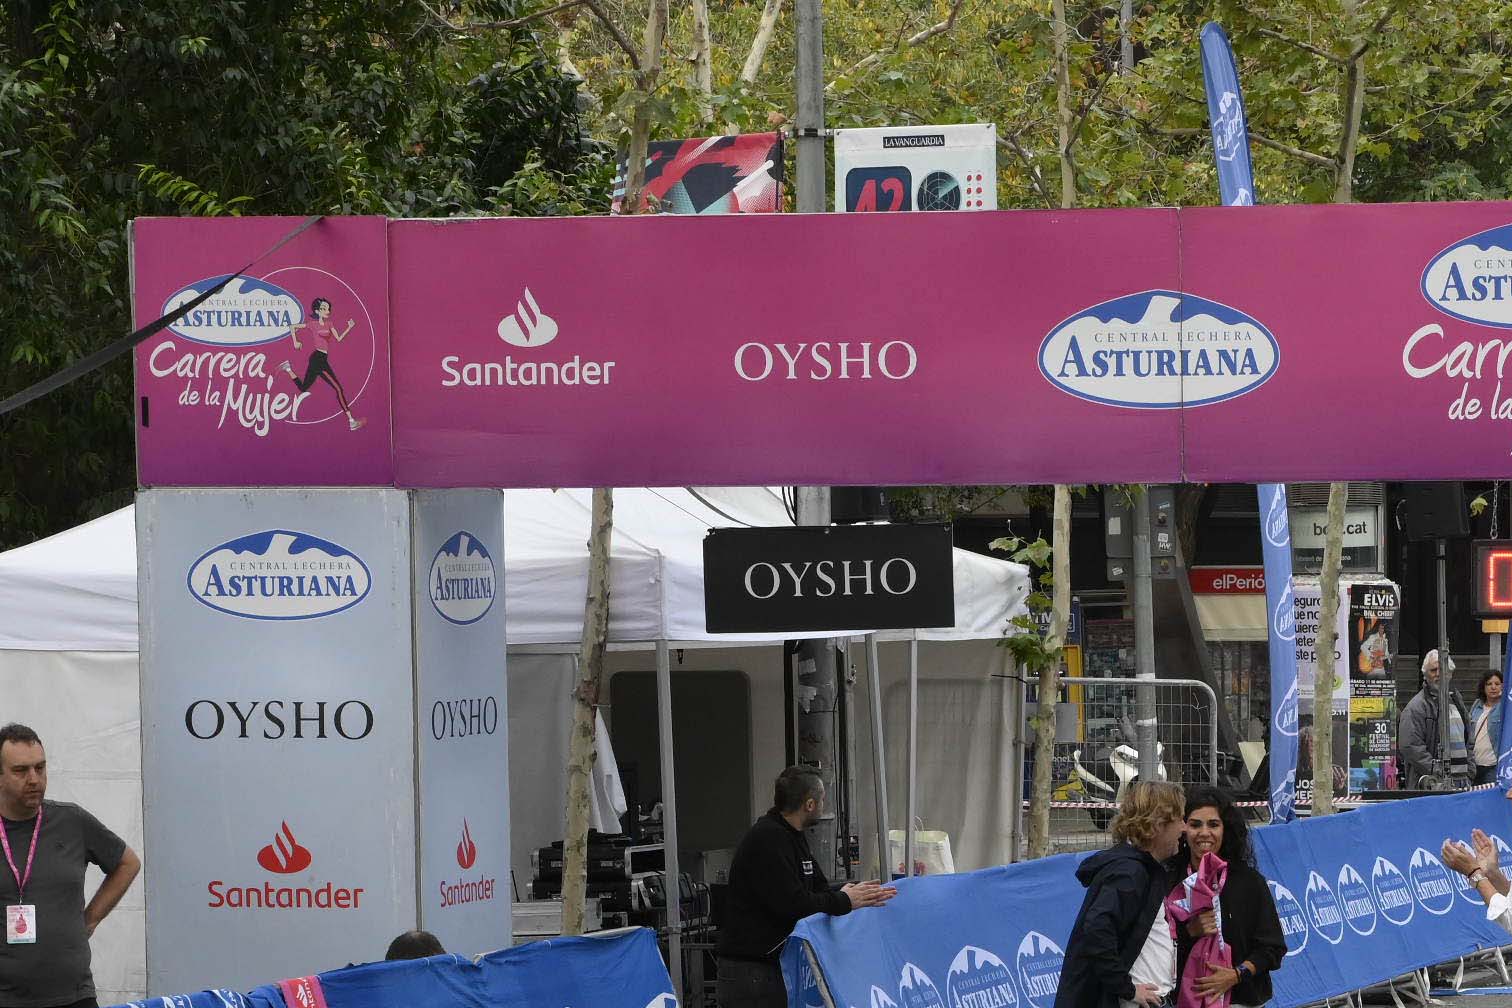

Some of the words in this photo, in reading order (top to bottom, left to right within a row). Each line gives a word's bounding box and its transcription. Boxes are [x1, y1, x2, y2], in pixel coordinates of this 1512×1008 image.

[885, 138, 894, 147] LA
[894, 136, 944, 147] VANGUARDIA
[173, 301, 293, 328] ASTURIANA
[201, 299, 239, 307] ENTRAL
[243, 299, 289, 307] LECHERA
[1094, 331, 1169, 342] CENTRAL
[1176, 330, 1254, 342] LECHERA
[149, 340, 266, 379] Carrera
[441, 355, 616, 388] Santander
[734, 340, 918, 381] OYSHO
[1056, 334, 1261, 378] ASTURIANA
[178, 380, 200, 406] de
[205, 379, 221, 406] la
[217, 375, 312, 437] Mujer
[1448, 382, 1483, 421] de
[201, 563, 359, 597] ASTURIANA
[230, 561, 288, 571] CENTRAL
[294, 560, 352, 571] LECHERA
[743, 557, 918, 599] OYSHO
[1212, 572, 1265, 591] elPerió
[434, 566, 493, 601] ASTURIANA
[1363, 593, 1395, 607] ELVIS
[1296, 650, 1310, 660] ste
[184, 699, 374, 740] OYSHO
[431, 695, 498, 741] OYSHO
[1374, 722, 1387, 734] 30
[207, 880, 364, 909] Santander
[440, 874, 496, 908] Santander
